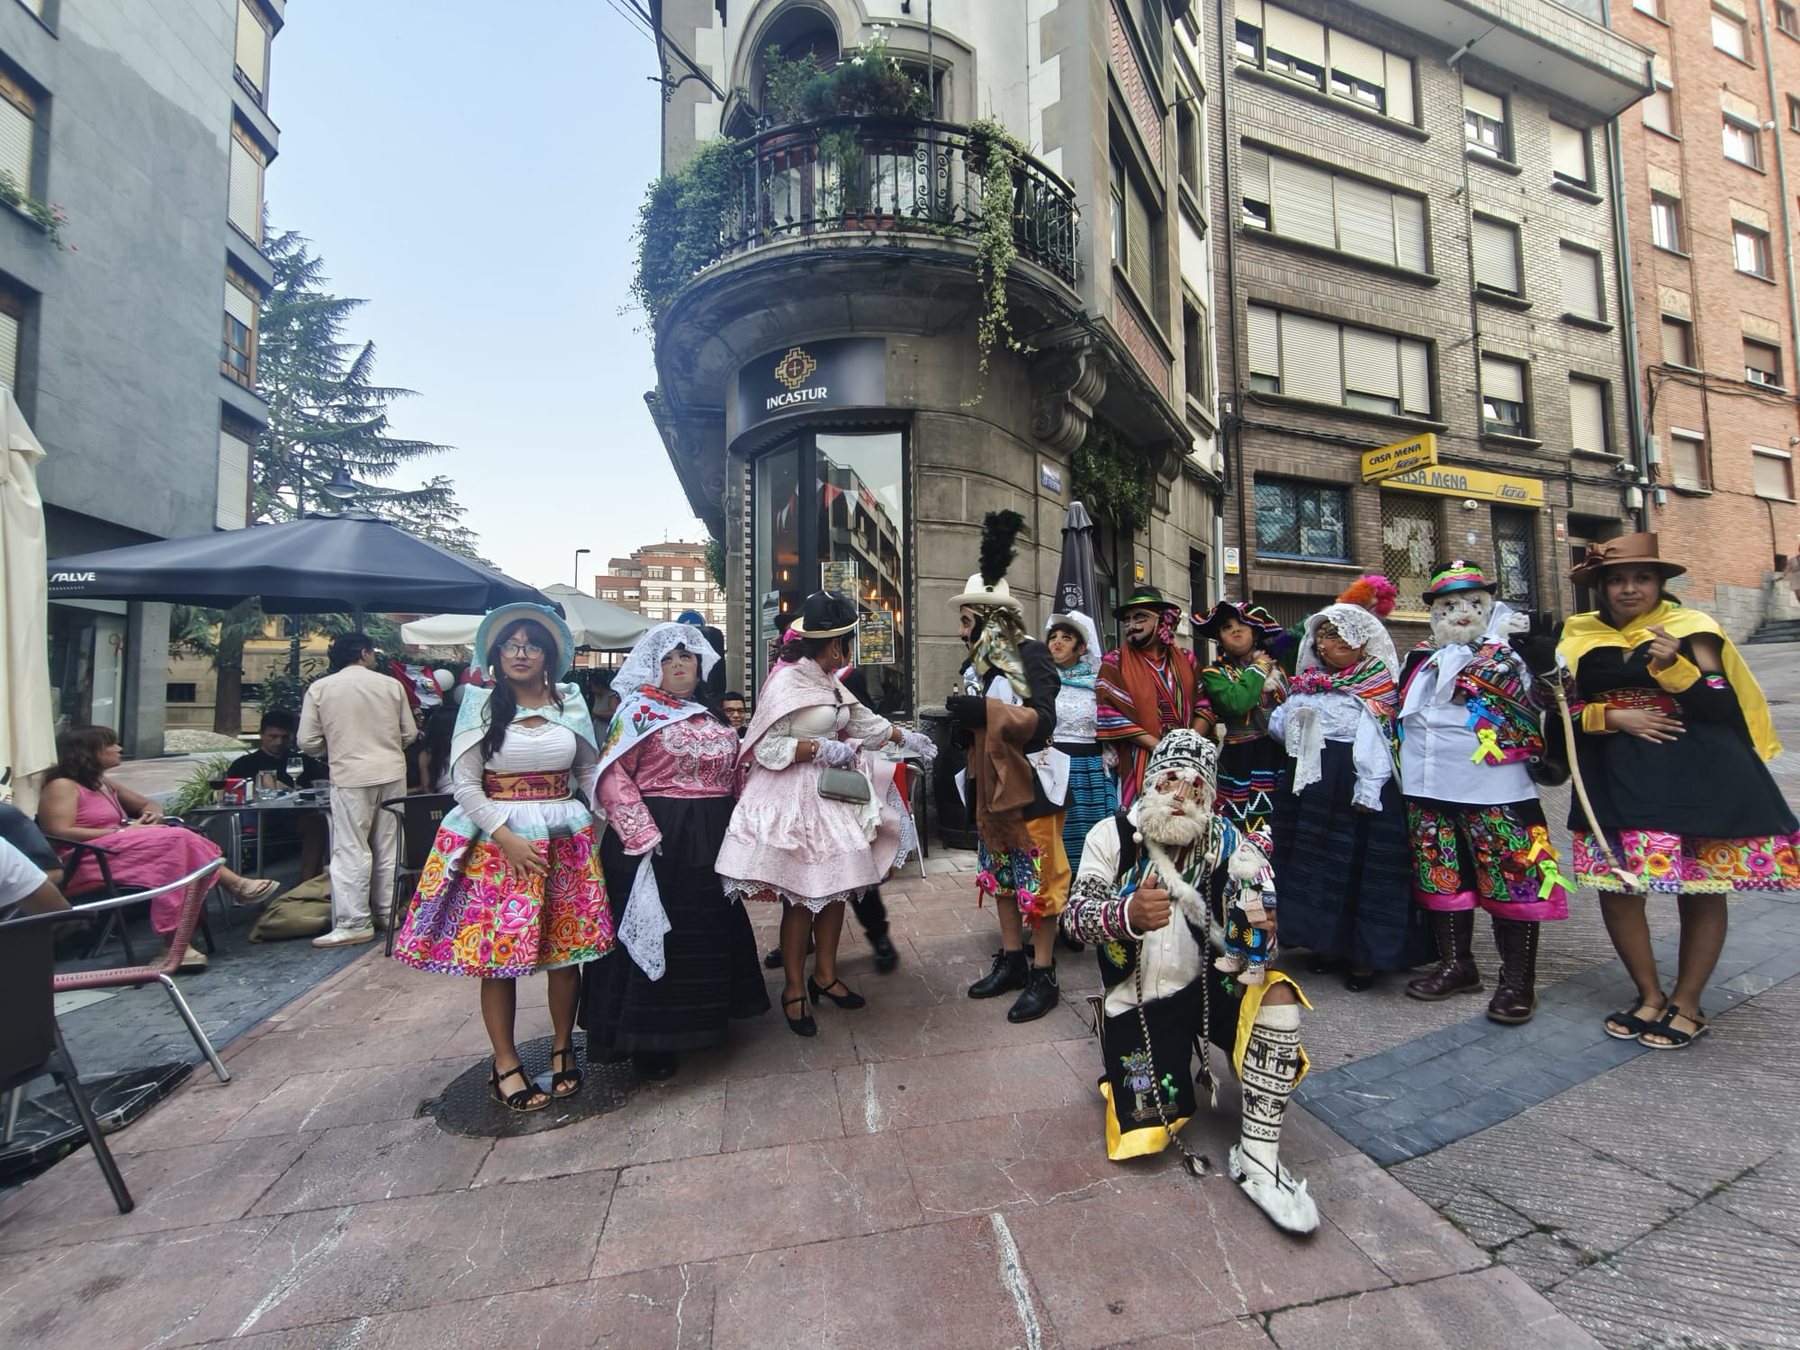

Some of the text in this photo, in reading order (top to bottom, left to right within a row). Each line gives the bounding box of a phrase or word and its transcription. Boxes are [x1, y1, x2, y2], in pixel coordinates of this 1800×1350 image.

[766, 386, 828, 410] INCASTUR
[1369, 443, 1422, 465] CASA MENA
[1432, 471, 1468, 491] MENA
[50, 572, 96, 582] SALVE
